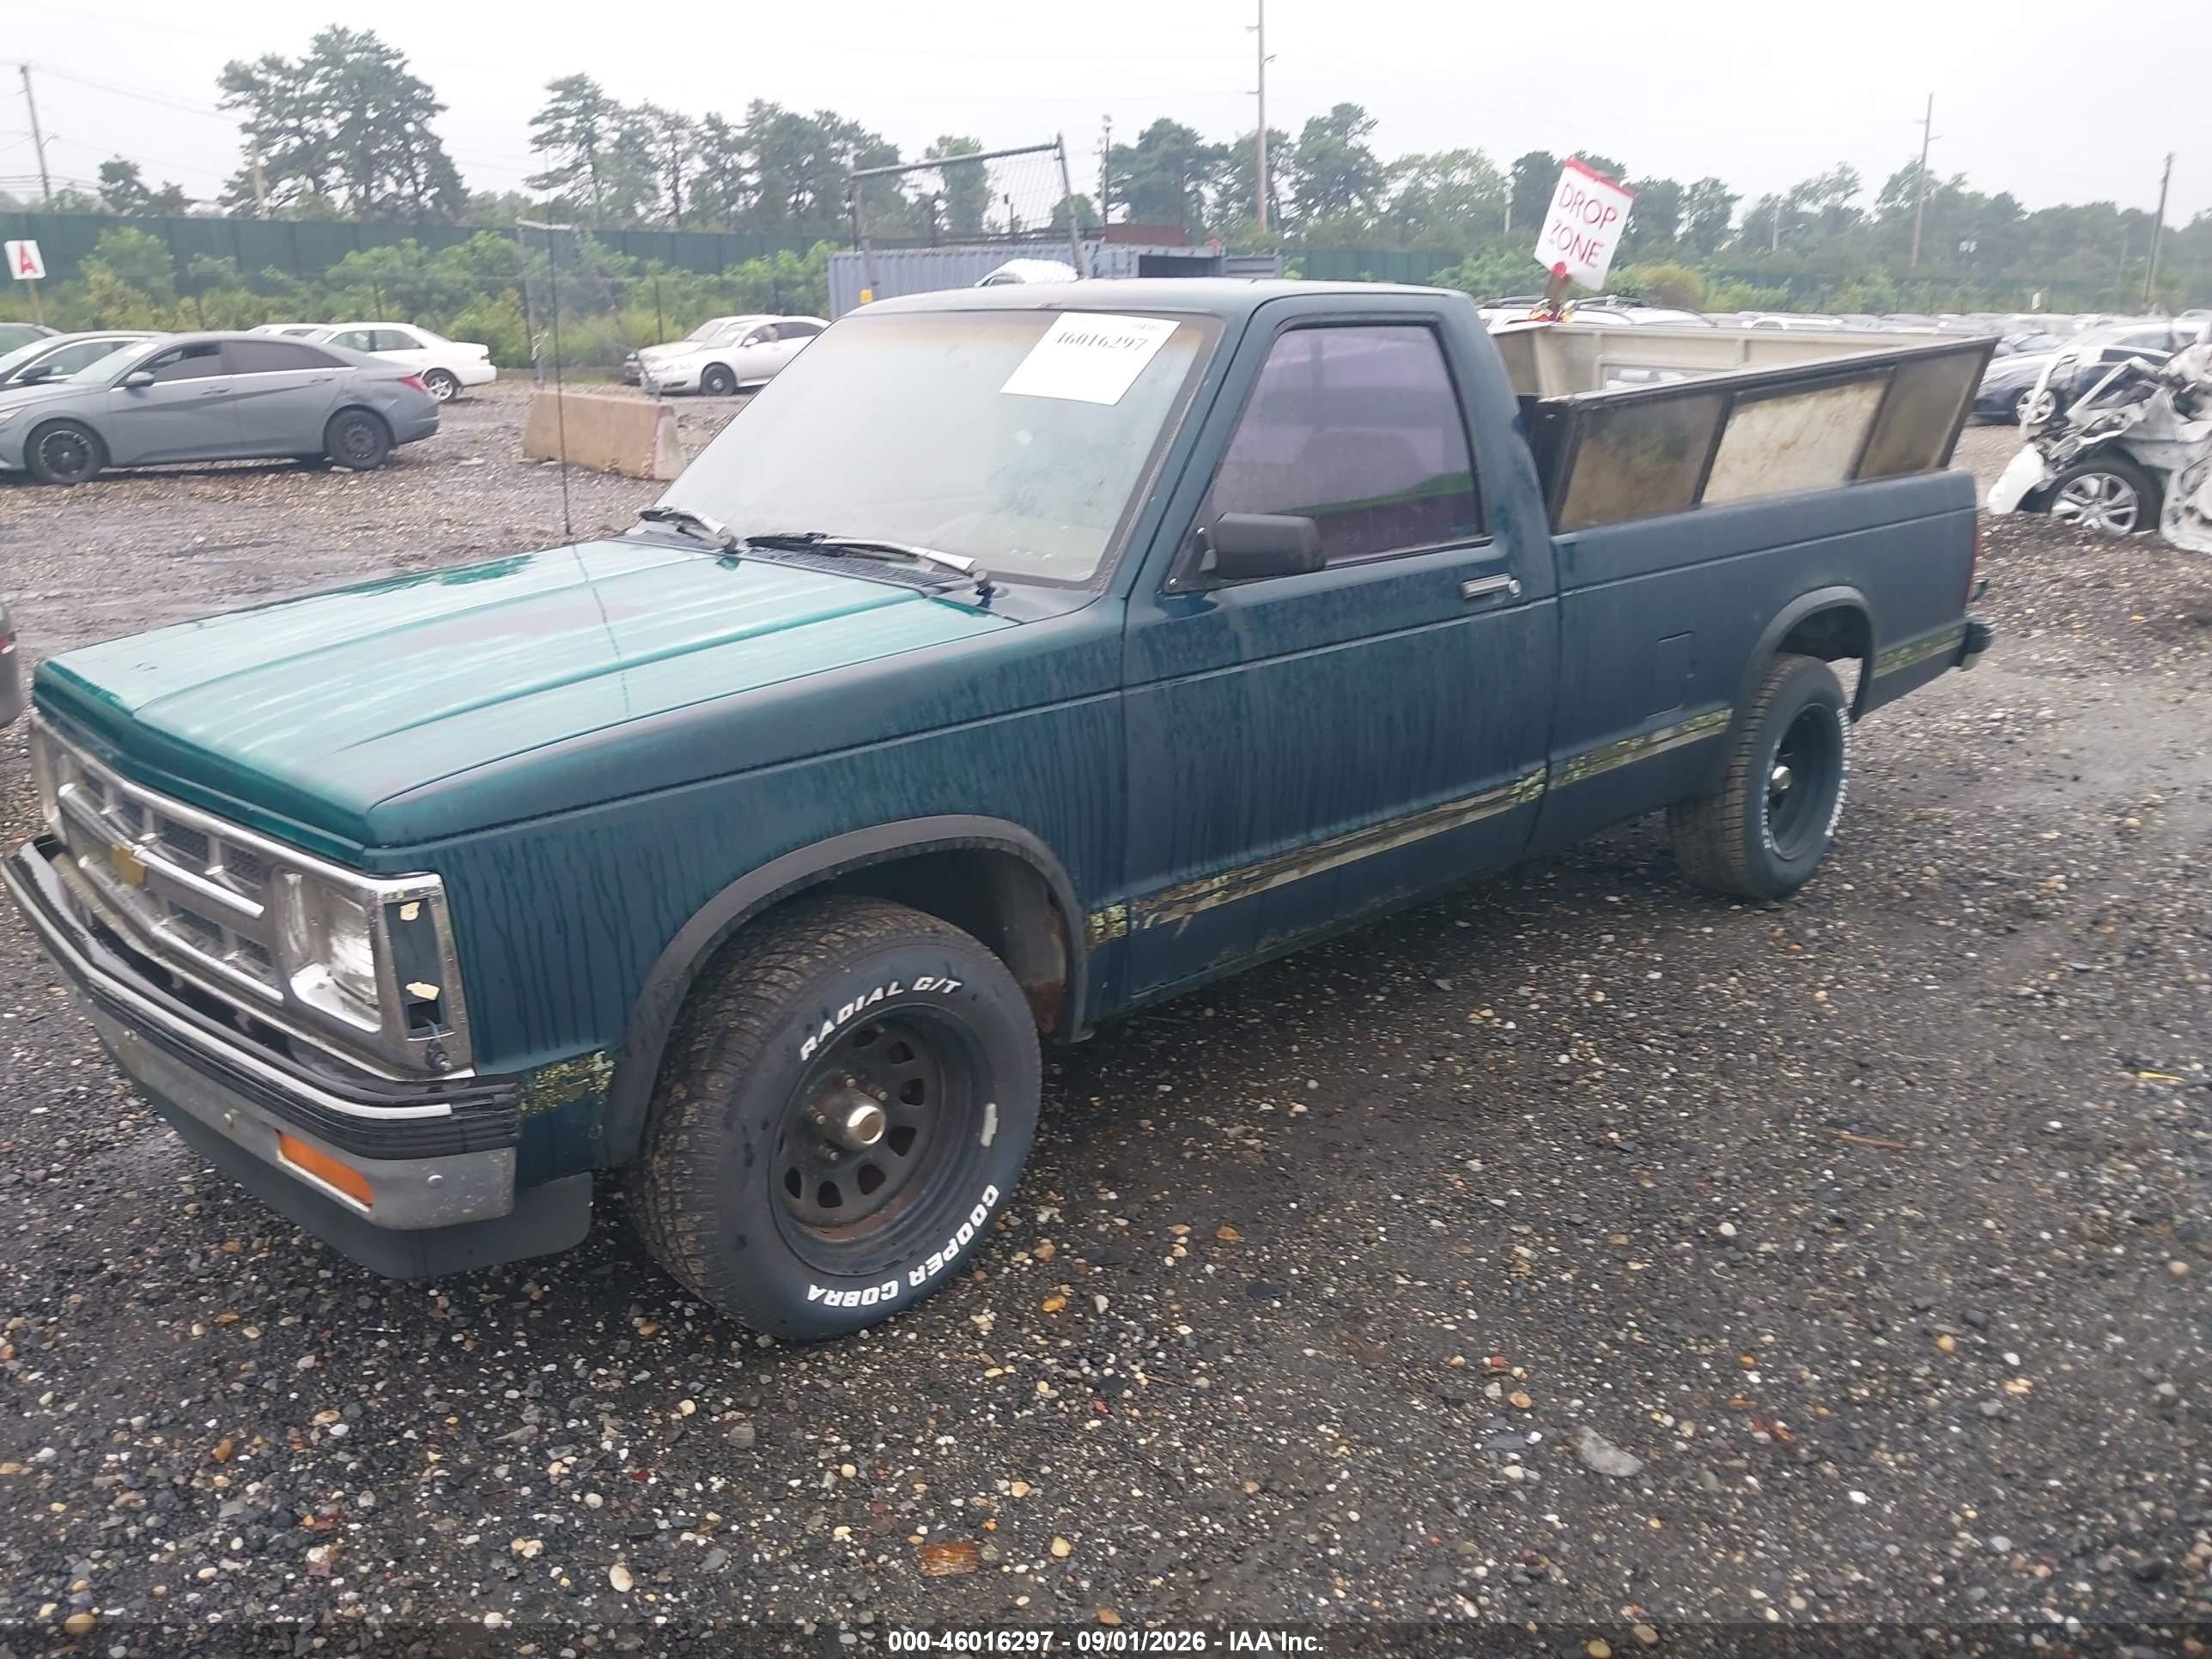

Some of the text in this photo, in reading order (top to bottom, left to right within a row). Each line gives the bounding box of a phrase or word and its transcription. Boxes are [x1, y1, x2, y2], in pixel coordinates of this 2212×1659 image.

[1559, 183, 1617, 229] DROP
[19, 244, 39, 274] A
[1550, 219, 1605, 268] ZONE
[799, 976, 962, 1060] RADIAL G/T
[806, 1184, 1000, 1307] COOPER COBRA
